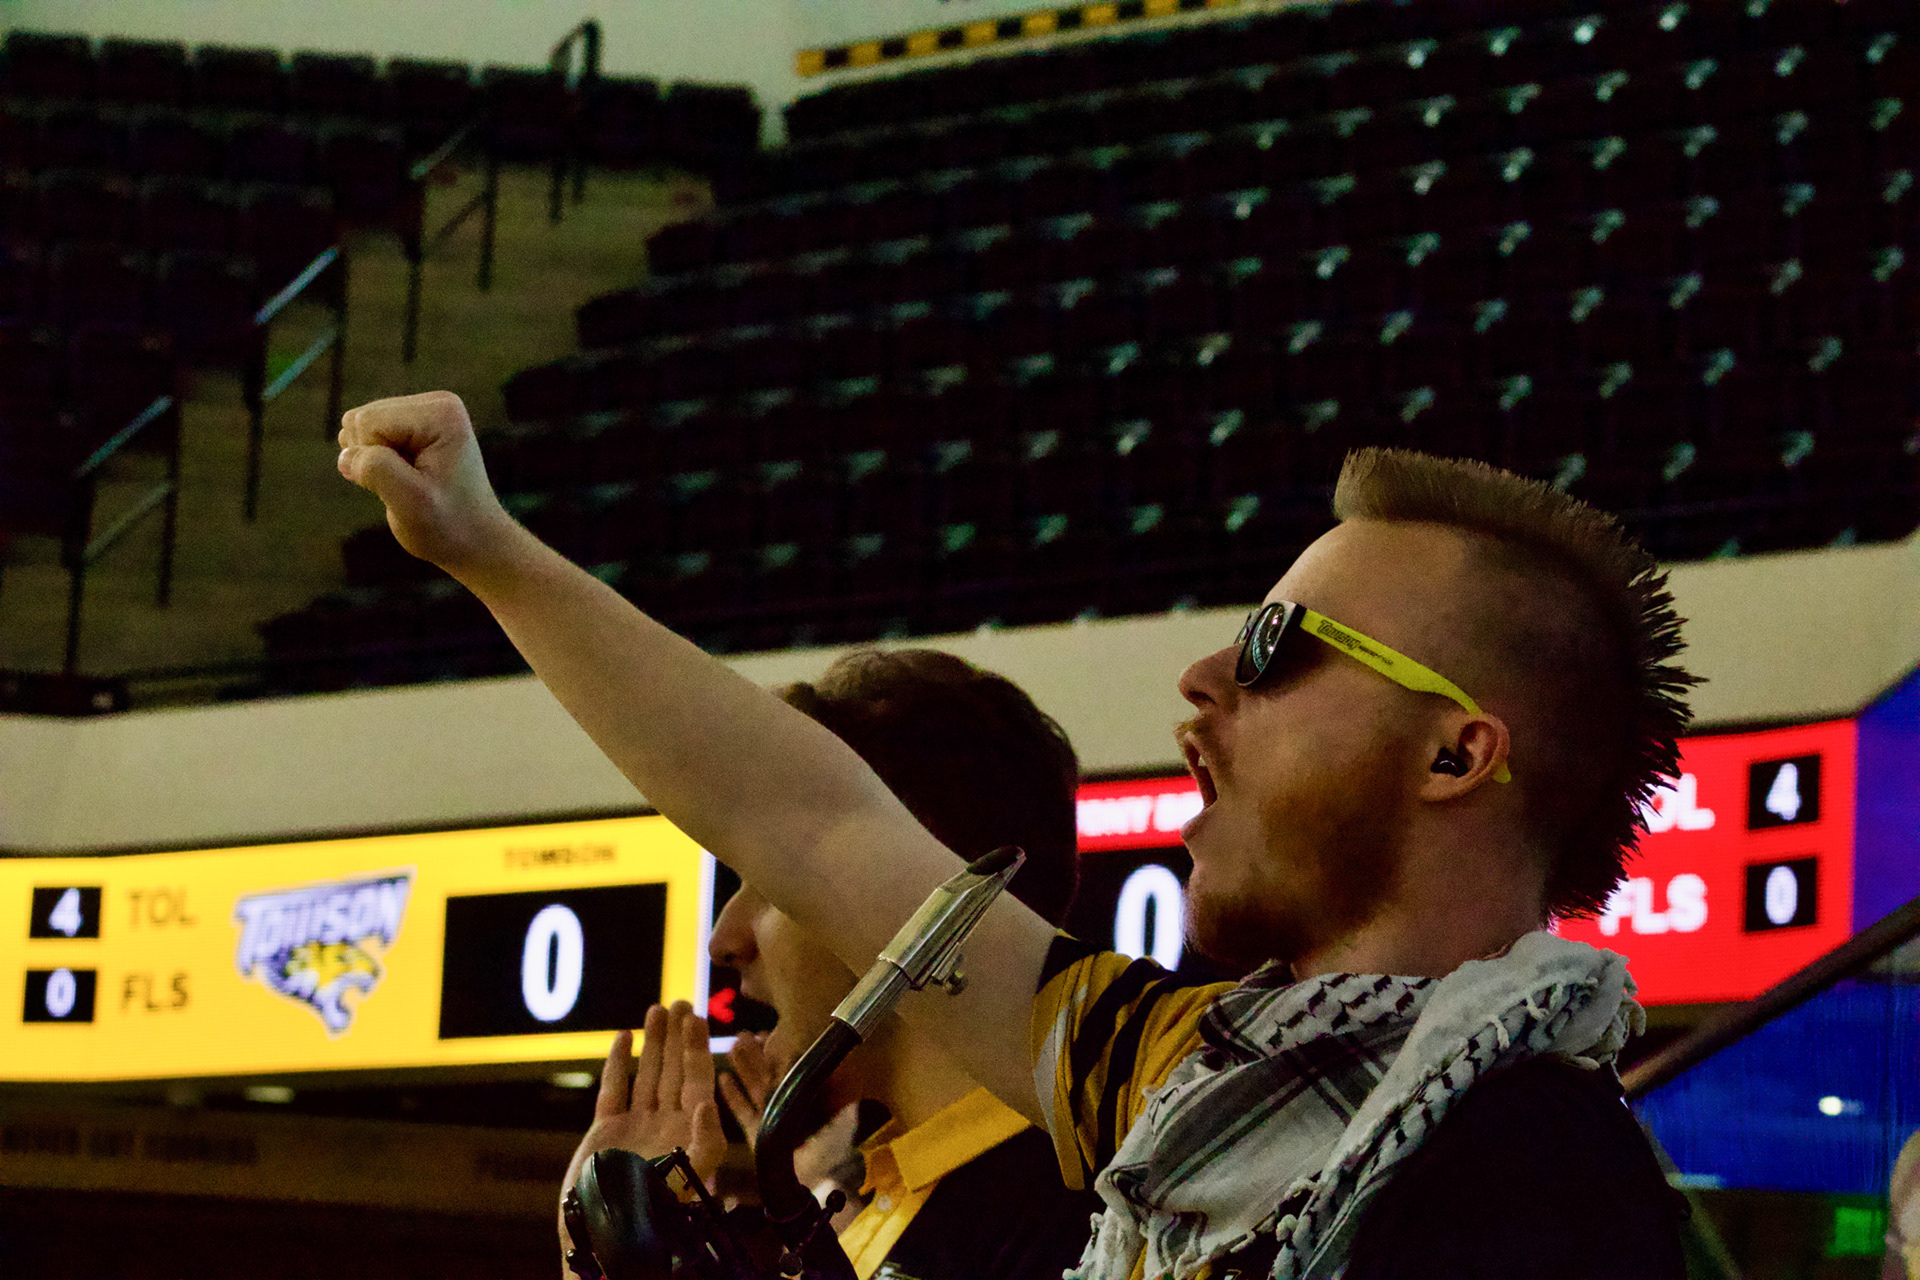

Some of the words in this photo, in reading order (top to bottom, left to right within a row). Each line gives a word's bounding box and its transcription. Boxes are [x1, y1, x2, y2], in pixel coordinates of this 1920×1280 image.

[1636, 773, 1716, 832] OL
[1765, 762, 1802, 821] 4
[49, 887, 83, 937] 4
[128, 889, 195, 928] TOL
[235, 876, 410, 974] TOWSON
[1114, 864, 1184, 972] 0
[1600, 873, 1708, 936] FLS
[1765, 865, 1798, 925] 0
[45, 967, 77, 1017] 0
[121, 972, 190, 1013] FLS
[521, 903, 585, 1023] 0
